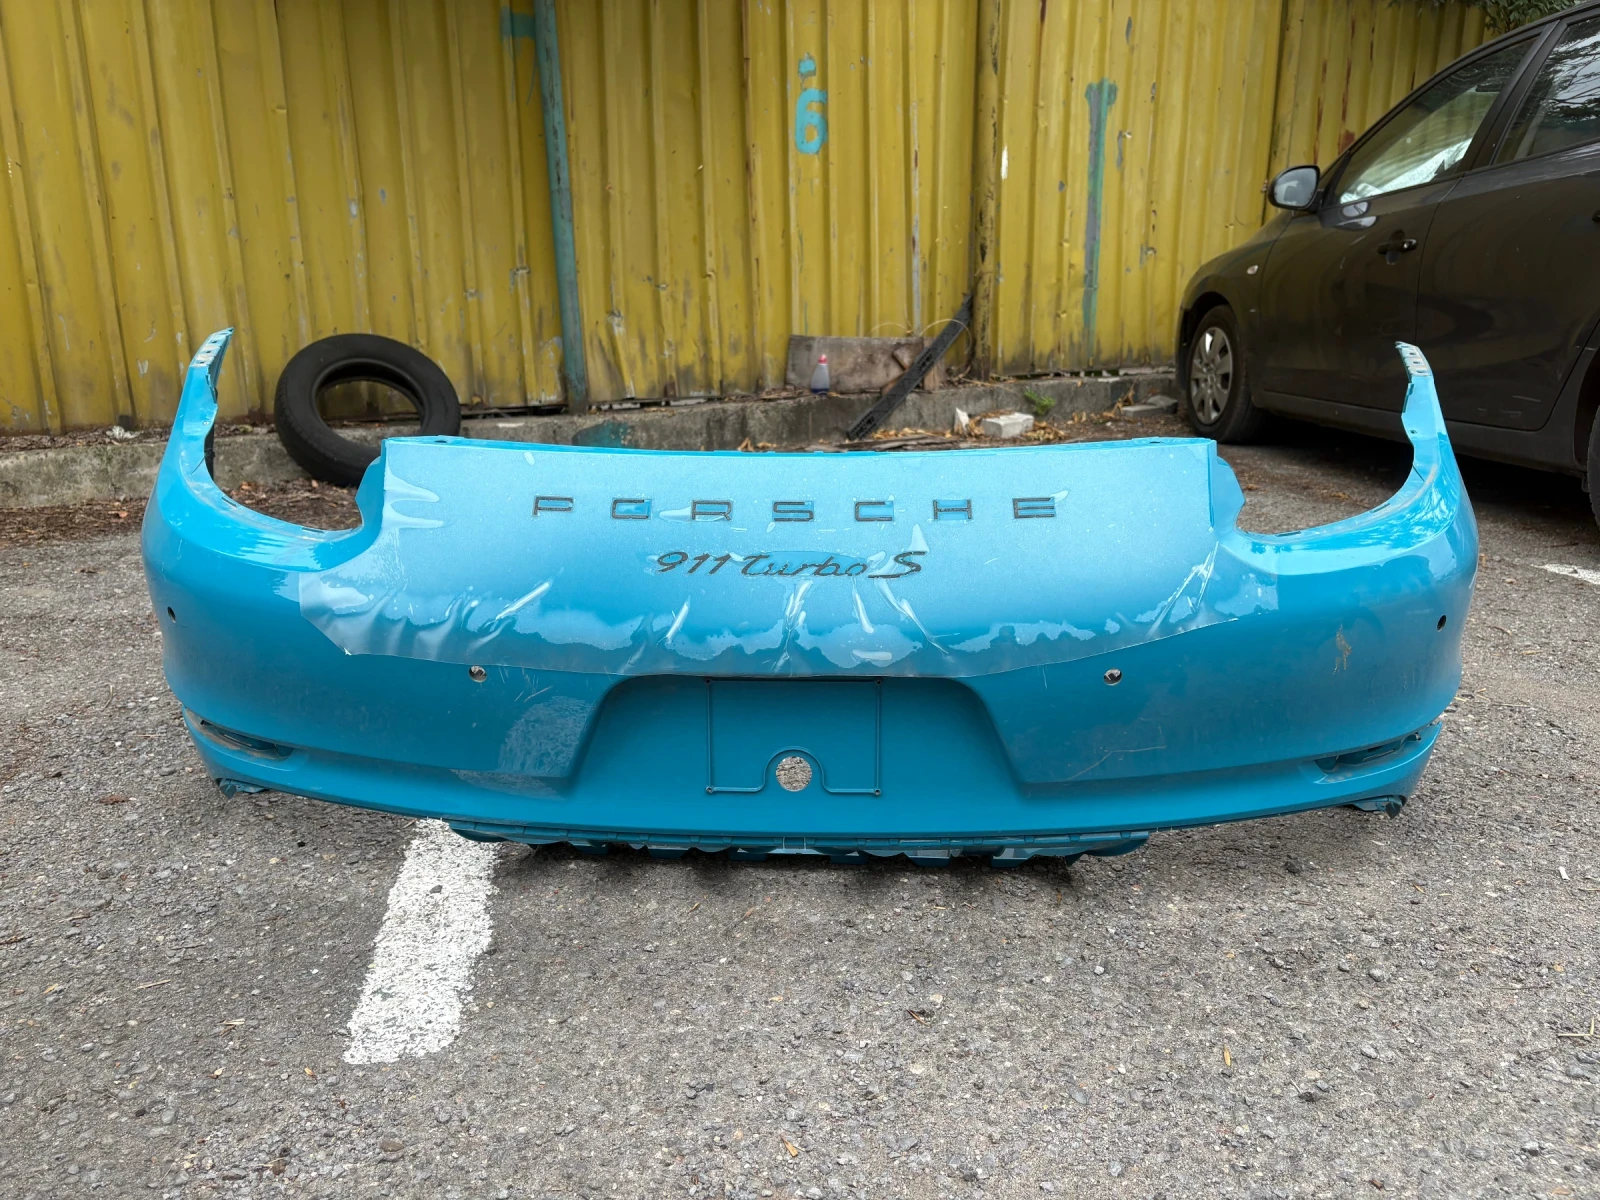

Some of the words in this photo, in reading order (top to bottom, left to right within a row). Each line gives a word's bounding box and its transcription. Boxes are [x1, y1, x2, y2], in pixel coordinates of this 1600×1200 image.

[794, 88, 828, 154] 6
[656, 551, 732, 575] 911
[867, 550, 927, 579] S
